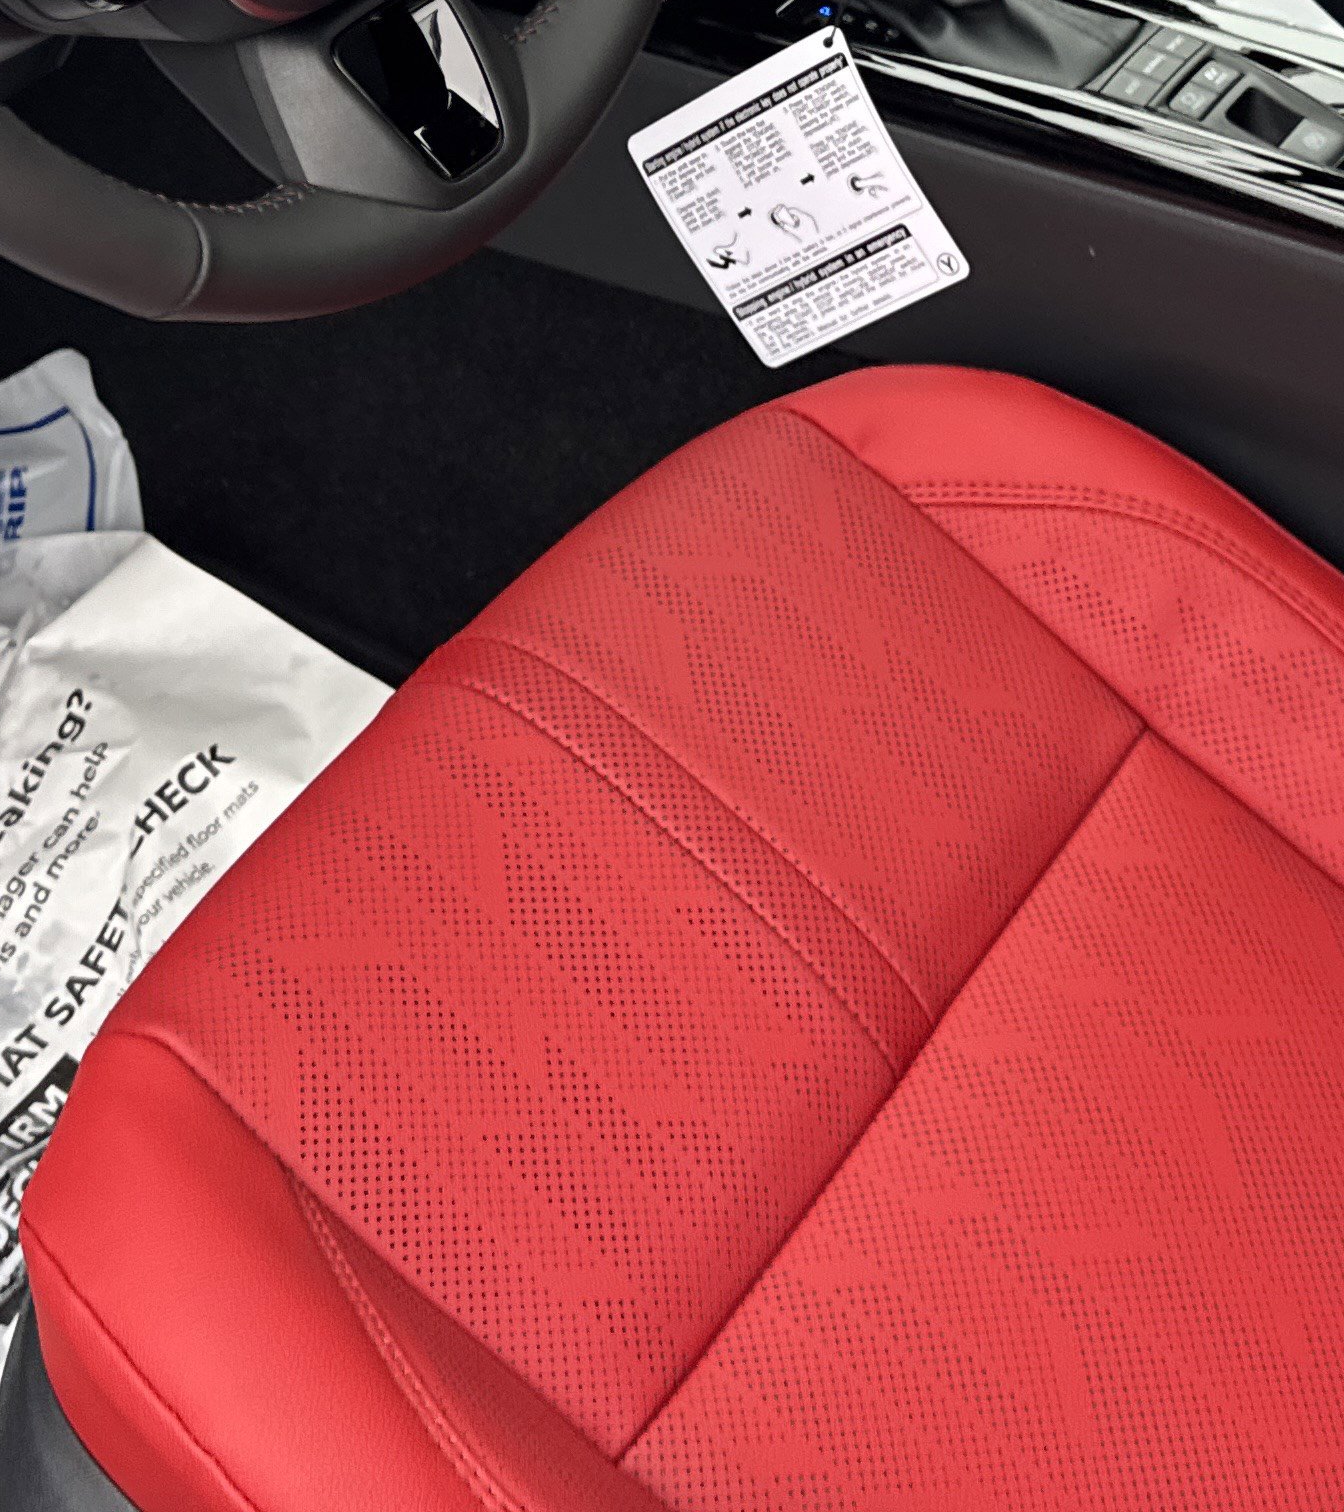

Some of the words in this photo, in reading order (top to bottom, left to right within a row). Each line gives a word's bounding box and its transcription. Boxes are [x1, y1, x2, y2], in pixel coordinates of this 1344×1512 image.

[42, 806, 80, 852] can
[69, 740, 111, 801] help
[186, 817, 223, 854] floor
[223, 780, 260, 821] mats
[14, 882, 53, 942] and
[137, 898, 163, 929] our
[44, 897, 131, 1027] SAFET
